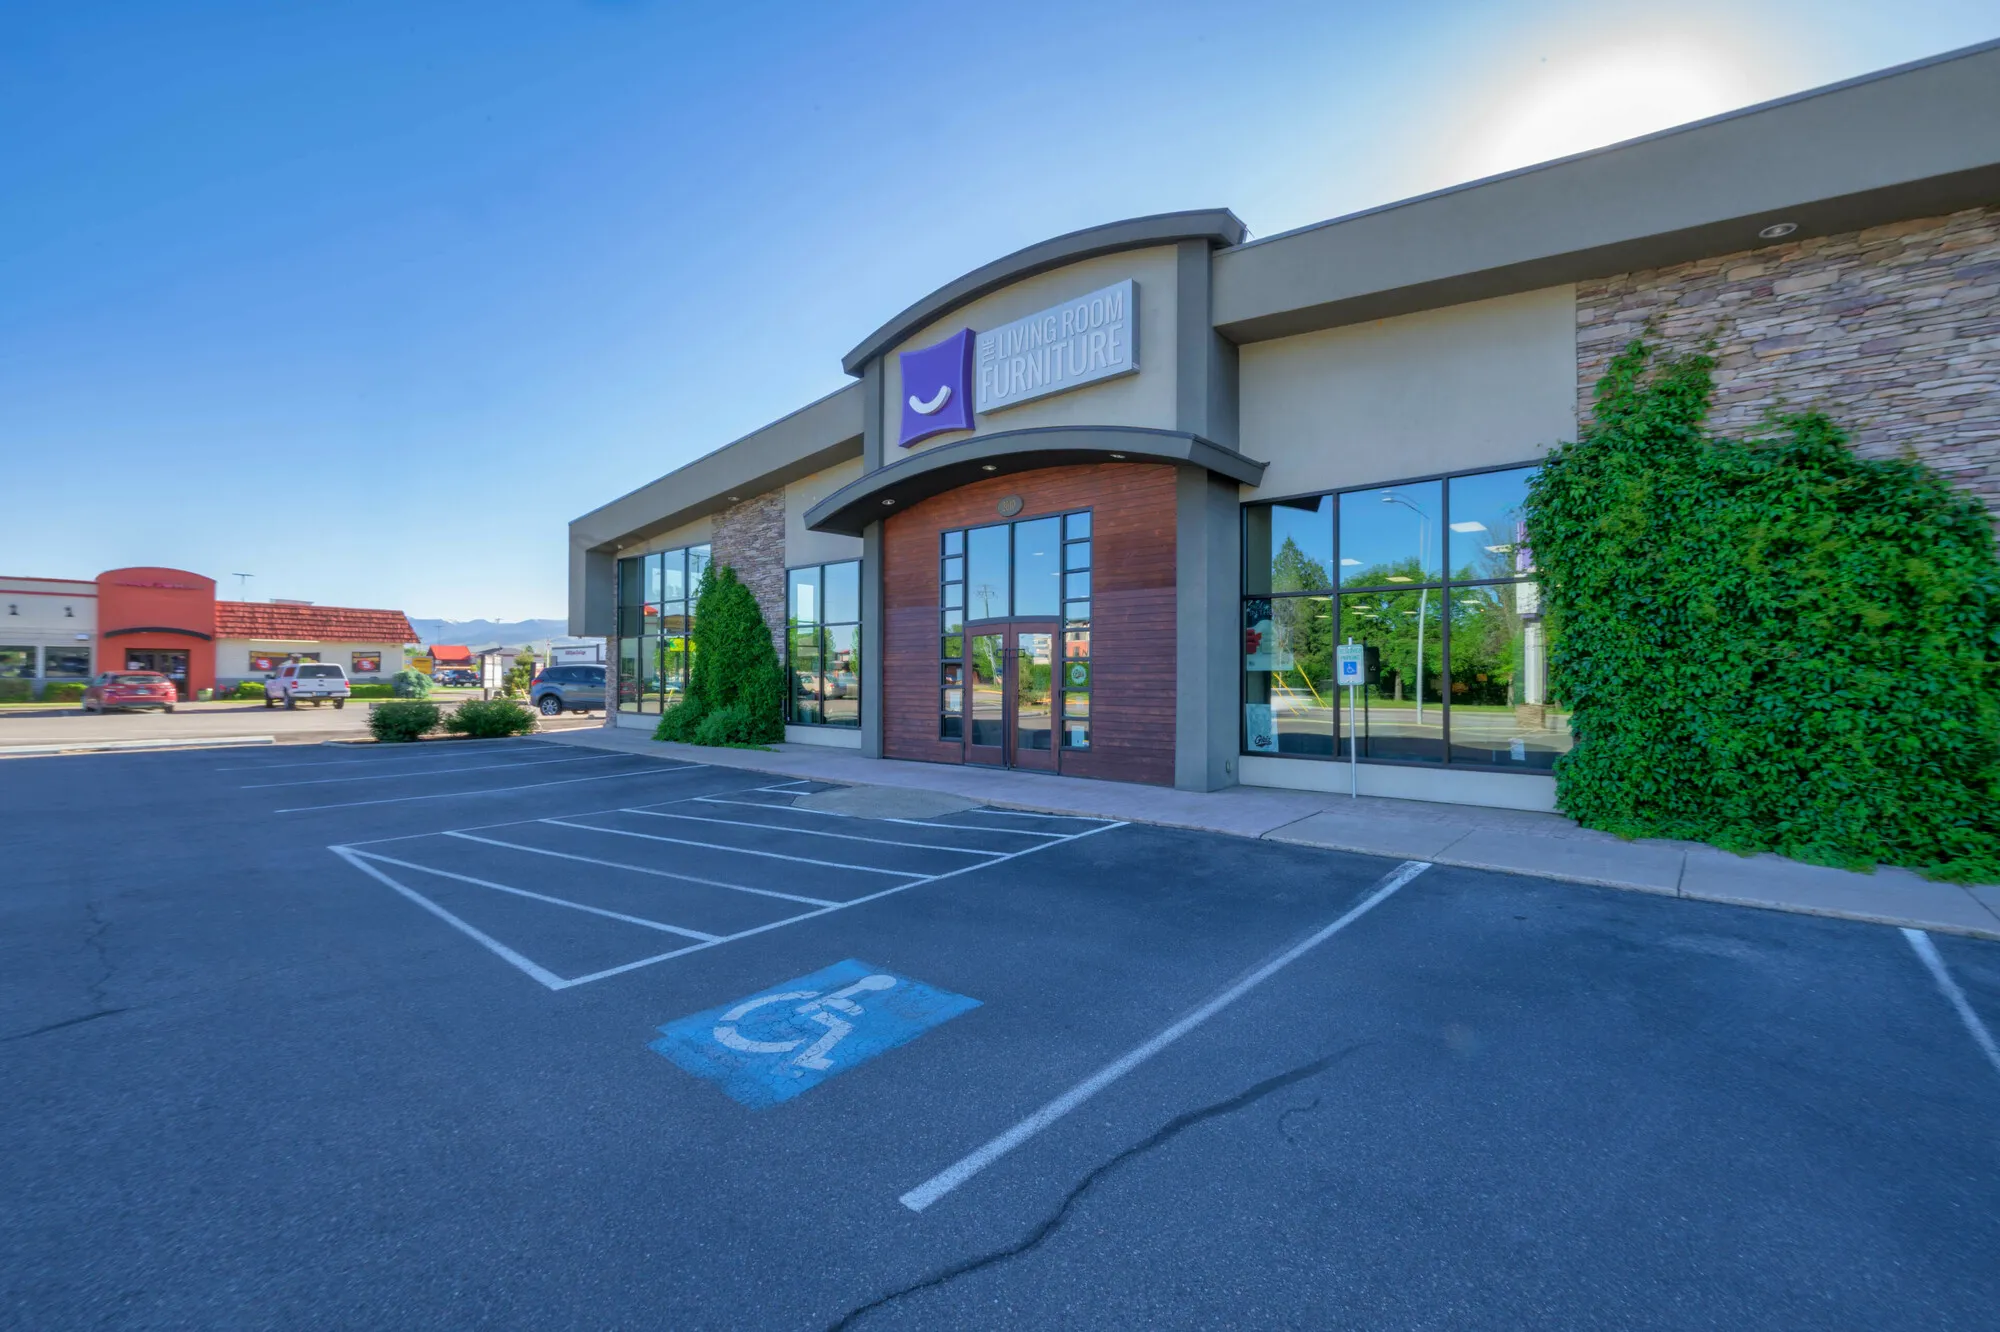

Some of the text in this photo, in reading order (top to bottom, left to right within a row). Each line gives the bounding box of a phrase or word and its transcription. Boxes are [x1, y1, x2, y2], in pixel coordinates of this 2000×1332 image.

[983, 336, 996, 366] THE
[1000, 290, 1124, 360] LIVING ROOM
[982, 322, 1124, 404] FURNITURE
